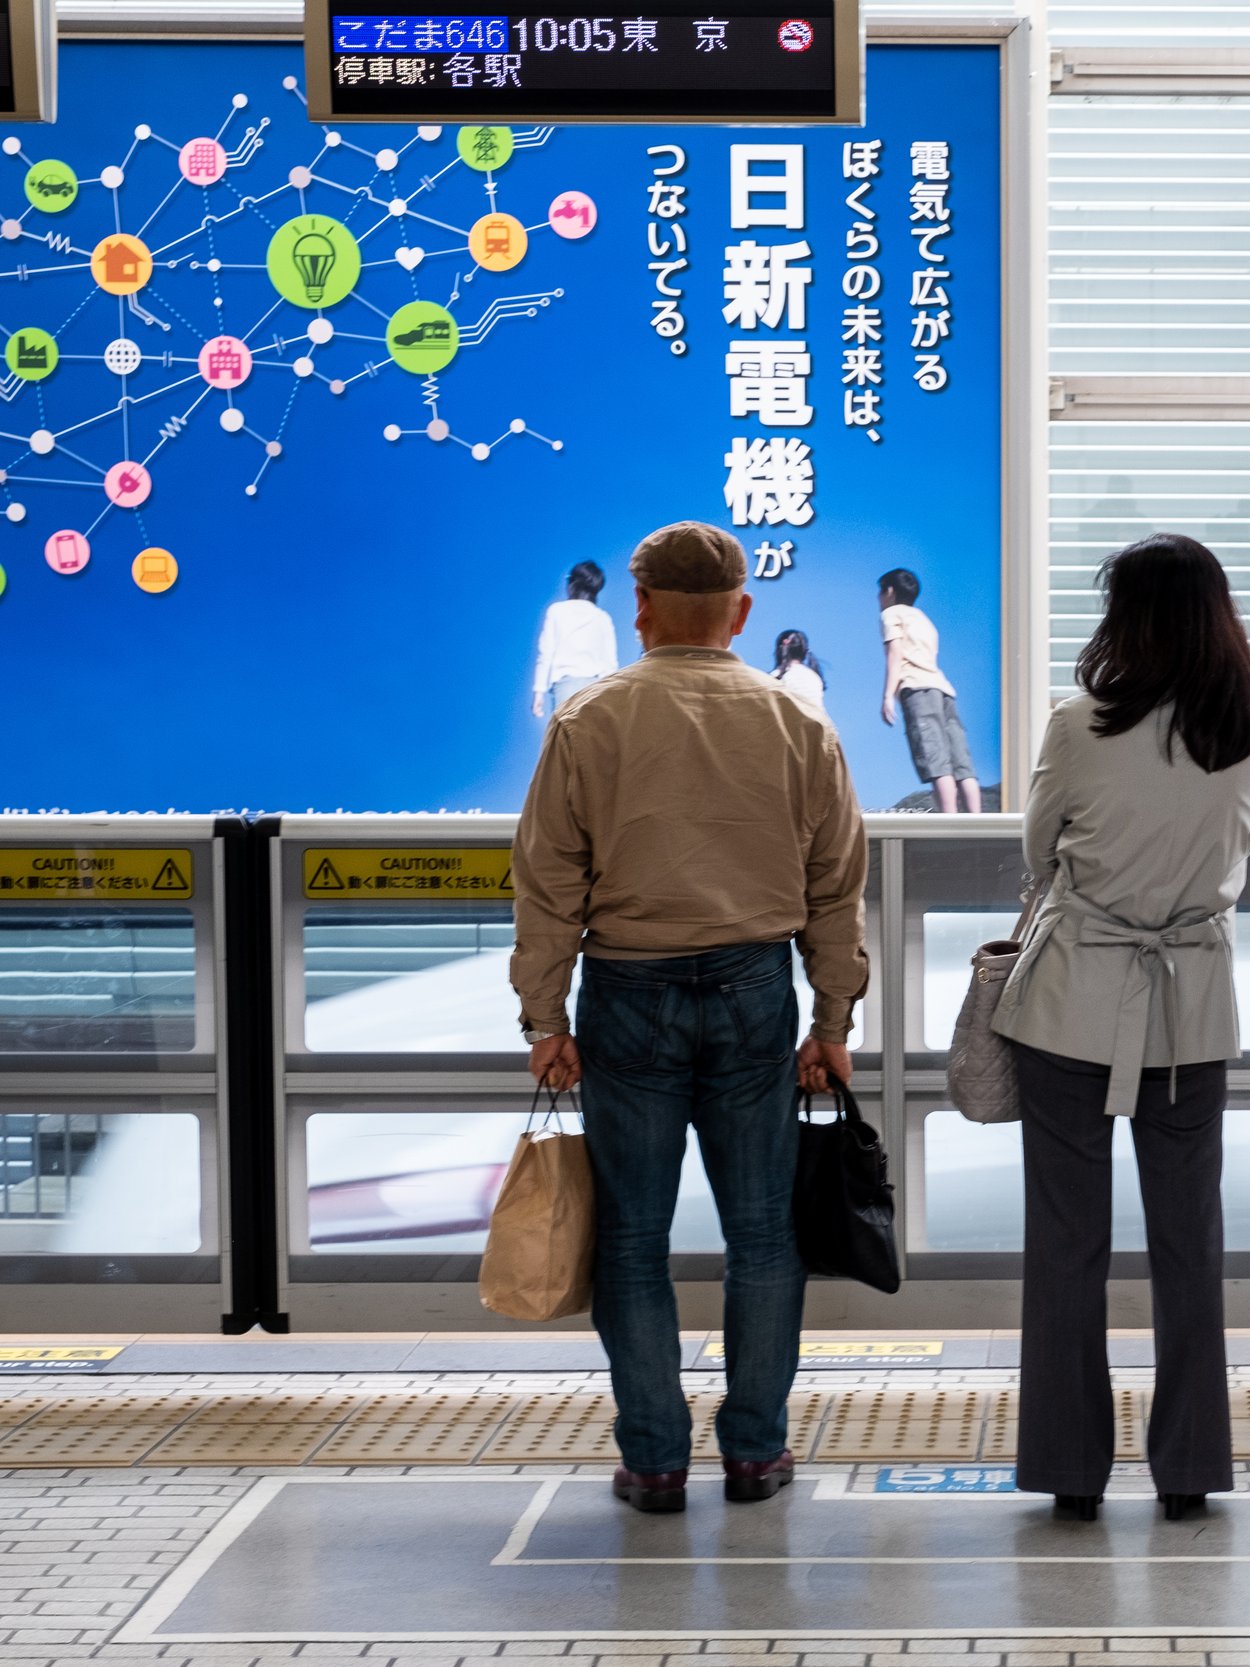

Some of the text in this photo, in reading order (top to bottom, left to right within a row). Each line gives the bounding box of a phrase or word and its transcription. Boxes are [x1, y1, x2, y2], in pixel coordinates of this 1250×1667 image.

[512, 17, 616, 52] 10:05
[841, 138, 883, 444] ぼくらの未来は、
[32, 857, 116, 871] CAUTION!!
[380, 857, 463, 871] CAUTION!!
[800, 1356, 931, 1366] your step.
